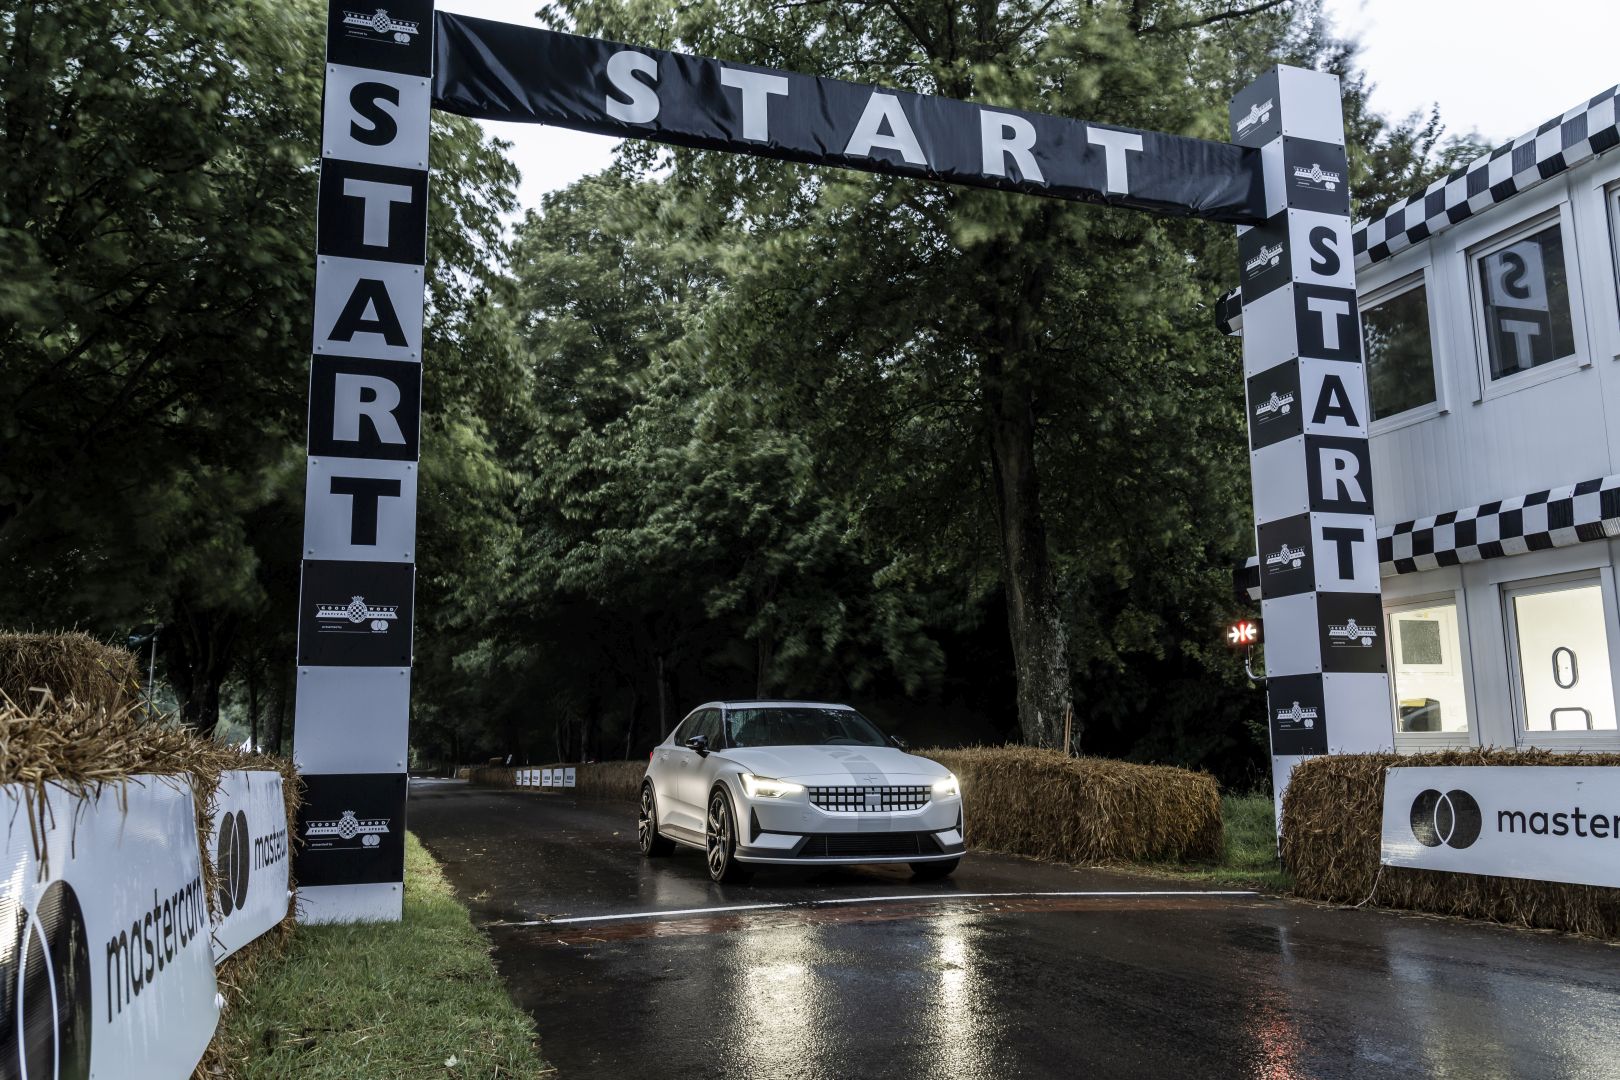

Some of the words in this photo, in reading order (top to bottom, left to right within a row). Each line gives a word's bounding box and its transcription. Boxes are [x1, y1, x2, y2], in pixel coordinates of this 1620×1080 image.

[605, 49, 1144, 195] START
[328, 81, 413, 546] START
[1308, 225, 1366, 580] START
[106, 857, 205, 1024] mastercard
